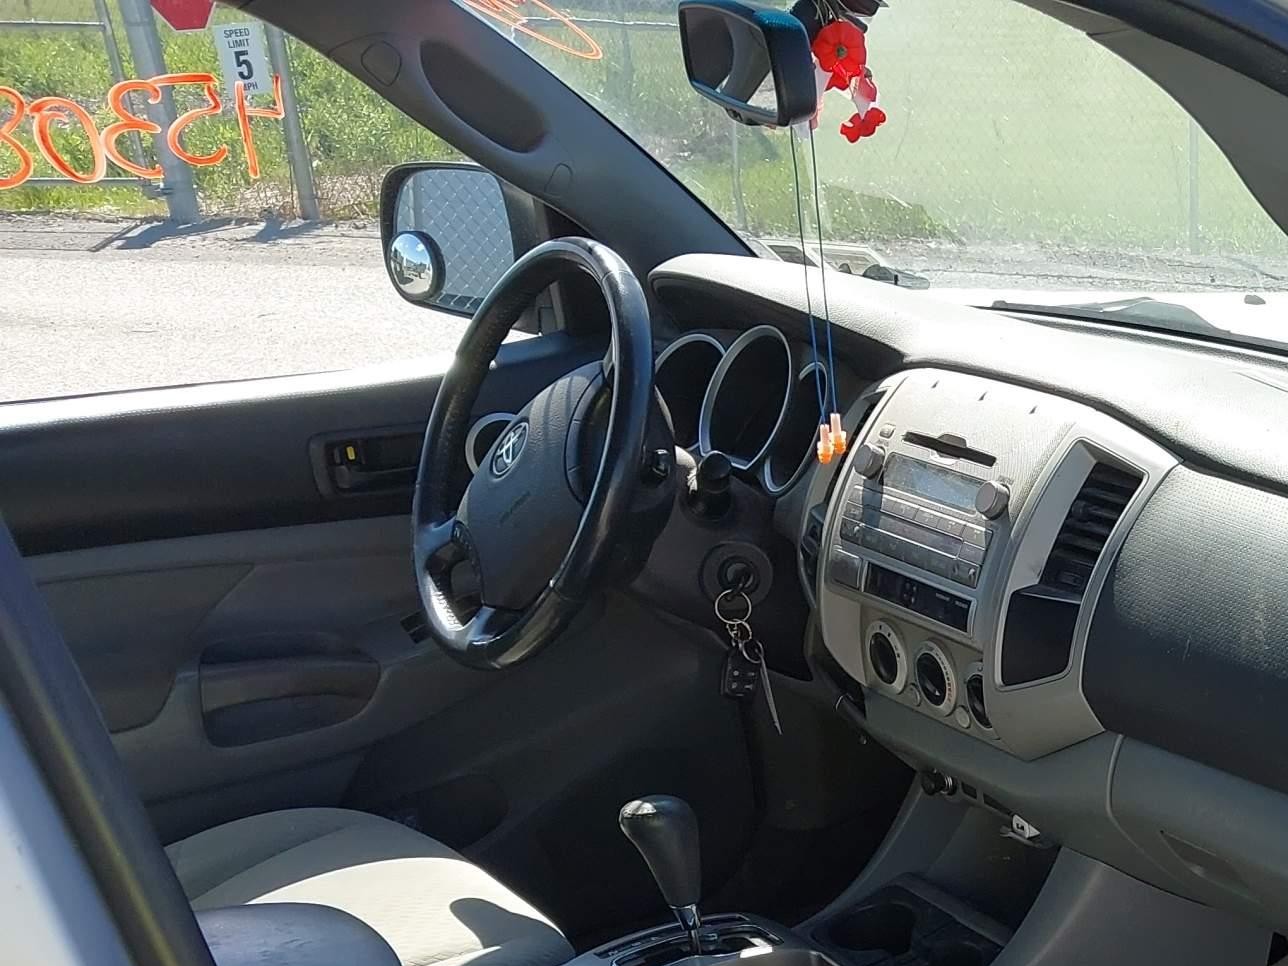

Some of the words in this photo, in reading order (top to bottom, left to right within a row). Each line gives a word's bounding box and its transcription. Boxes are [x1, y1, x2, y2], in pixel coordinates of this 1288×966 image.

[223, 28, 250, 39] SPEED
[227, 39, 249, 49] LIMIT
[234, 50, 253, 80] 5
